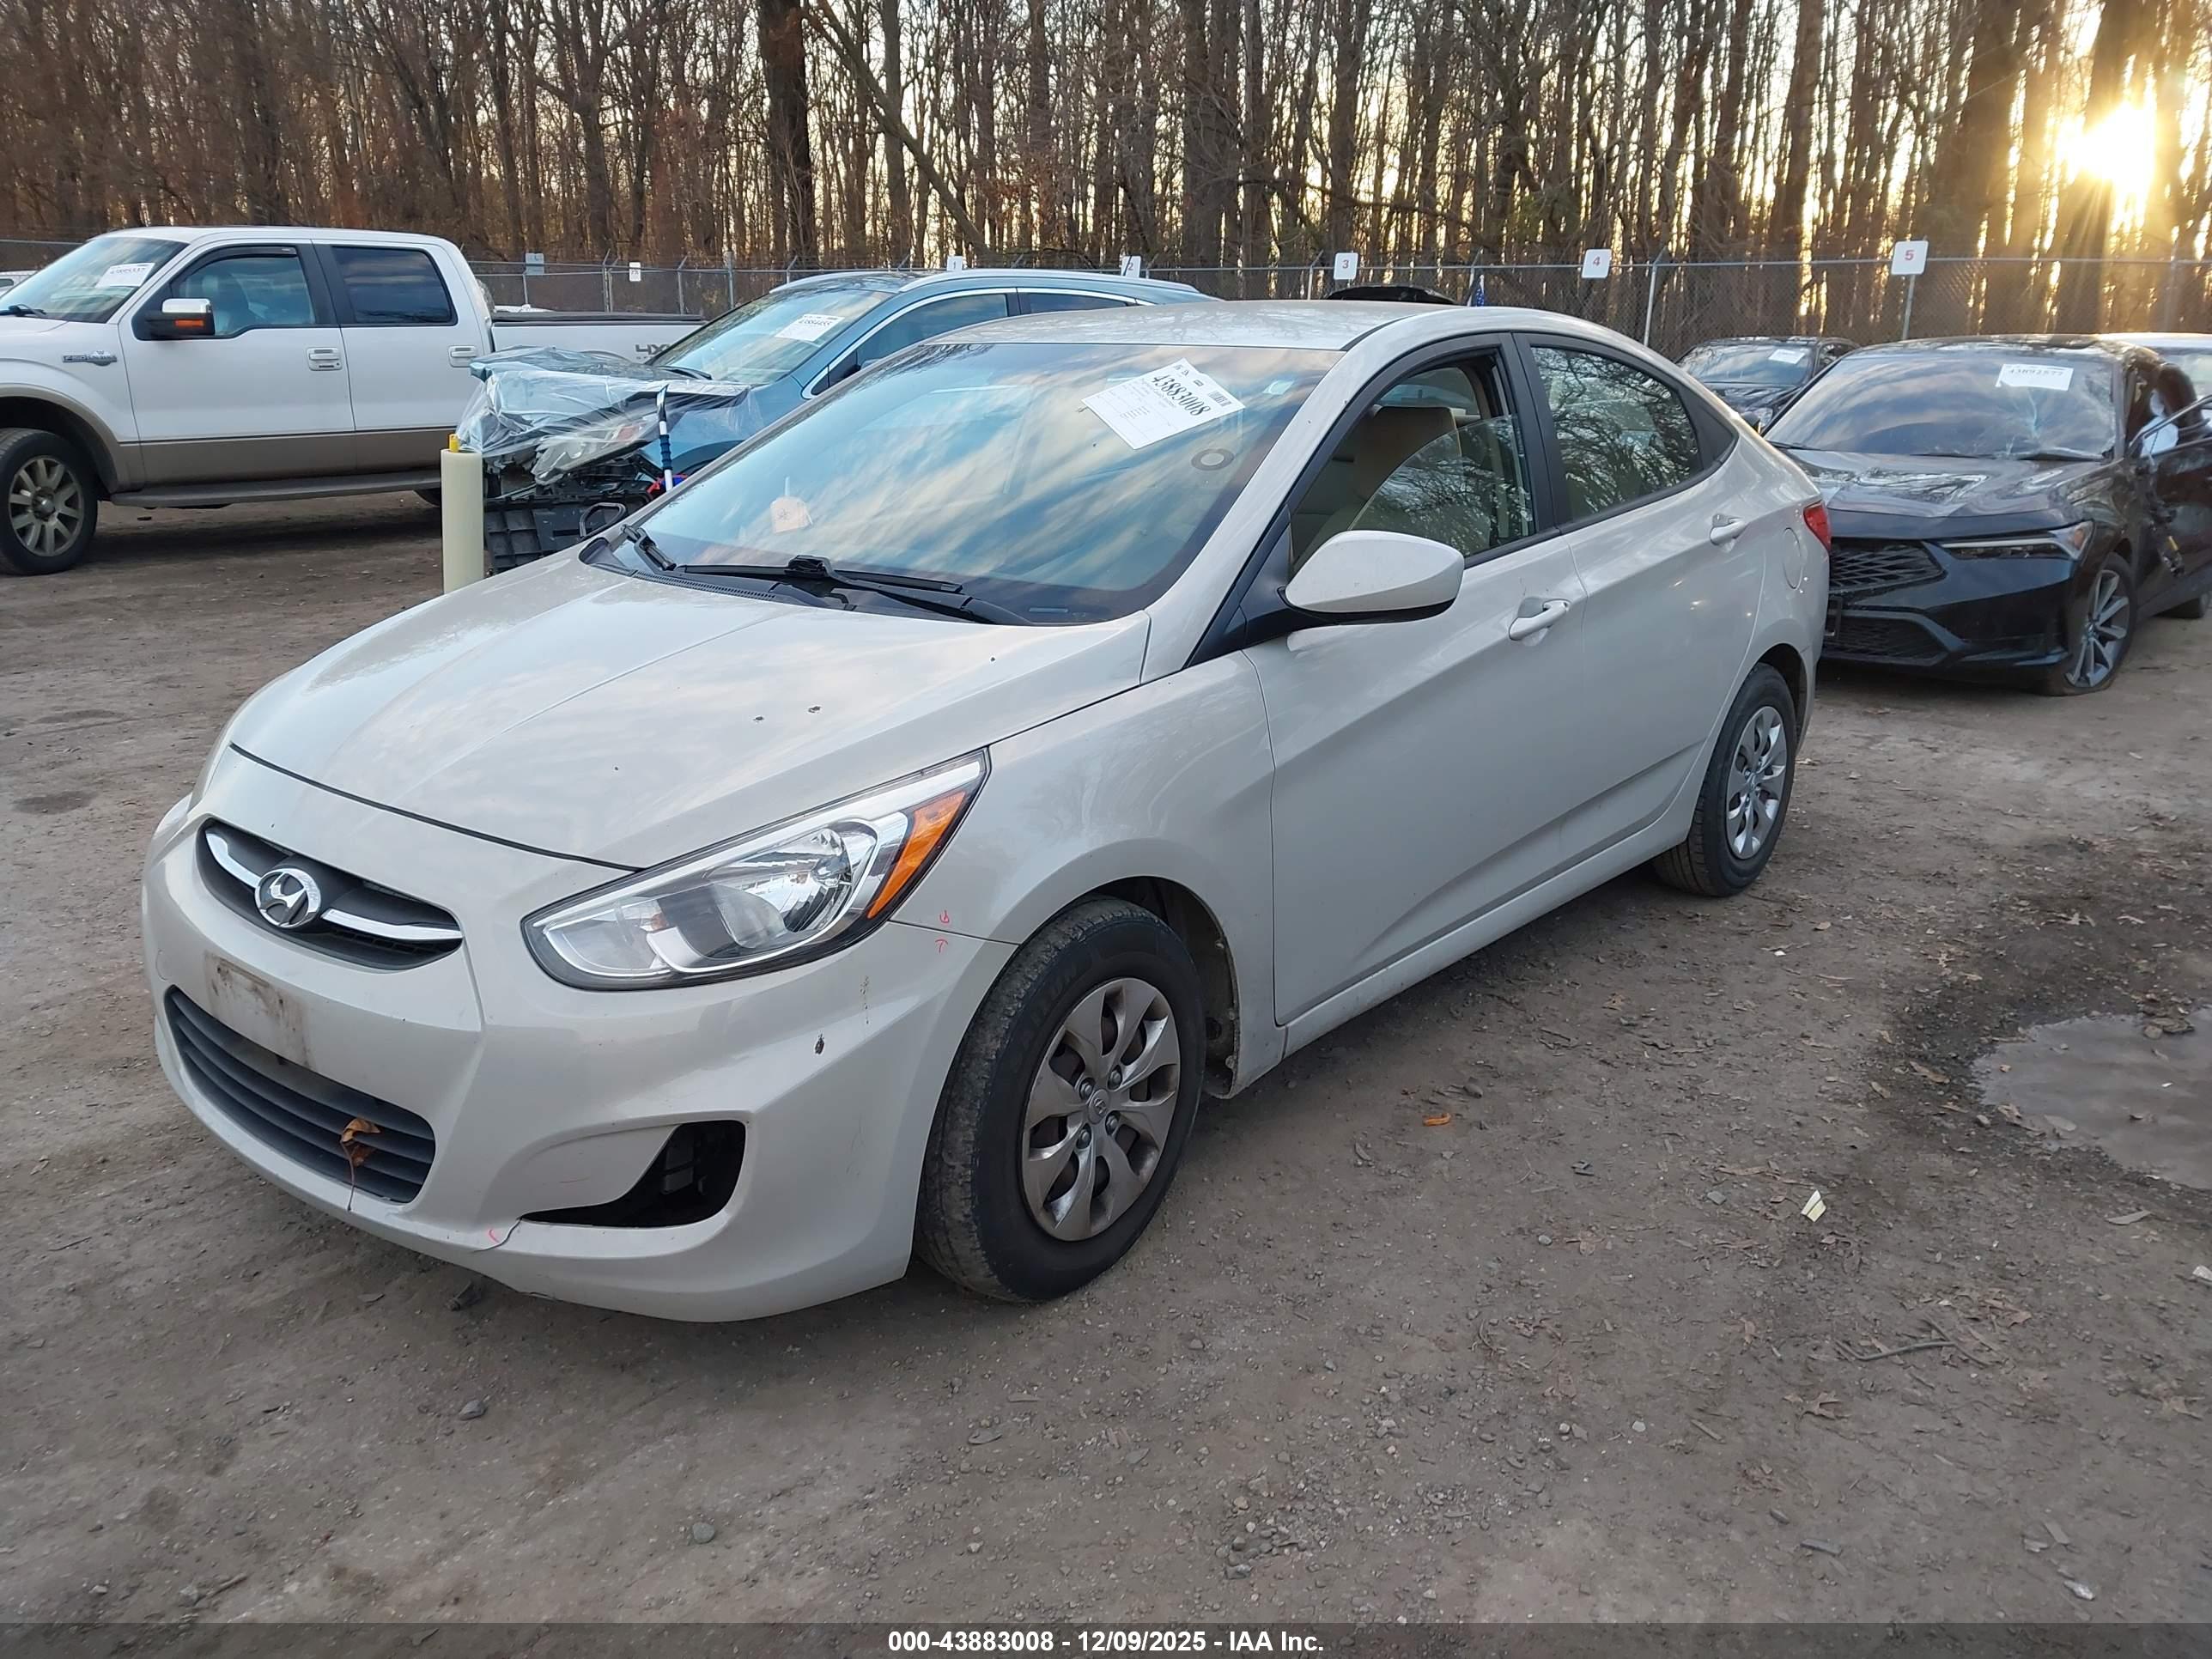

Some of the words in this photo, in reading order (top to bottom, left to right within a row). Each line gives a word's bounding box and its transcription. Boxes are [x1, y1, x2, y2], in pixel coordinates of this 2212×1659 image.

[1905, 249, 1915, 261] 5
[1127, 262, 1133, 270] 2
[1342, 259, 1349, 269] 3
[1592, 256, 1601, 267] 4
[635, 343, 670, 356] 4X
[1152, 374, 1211, 416] 43883008
